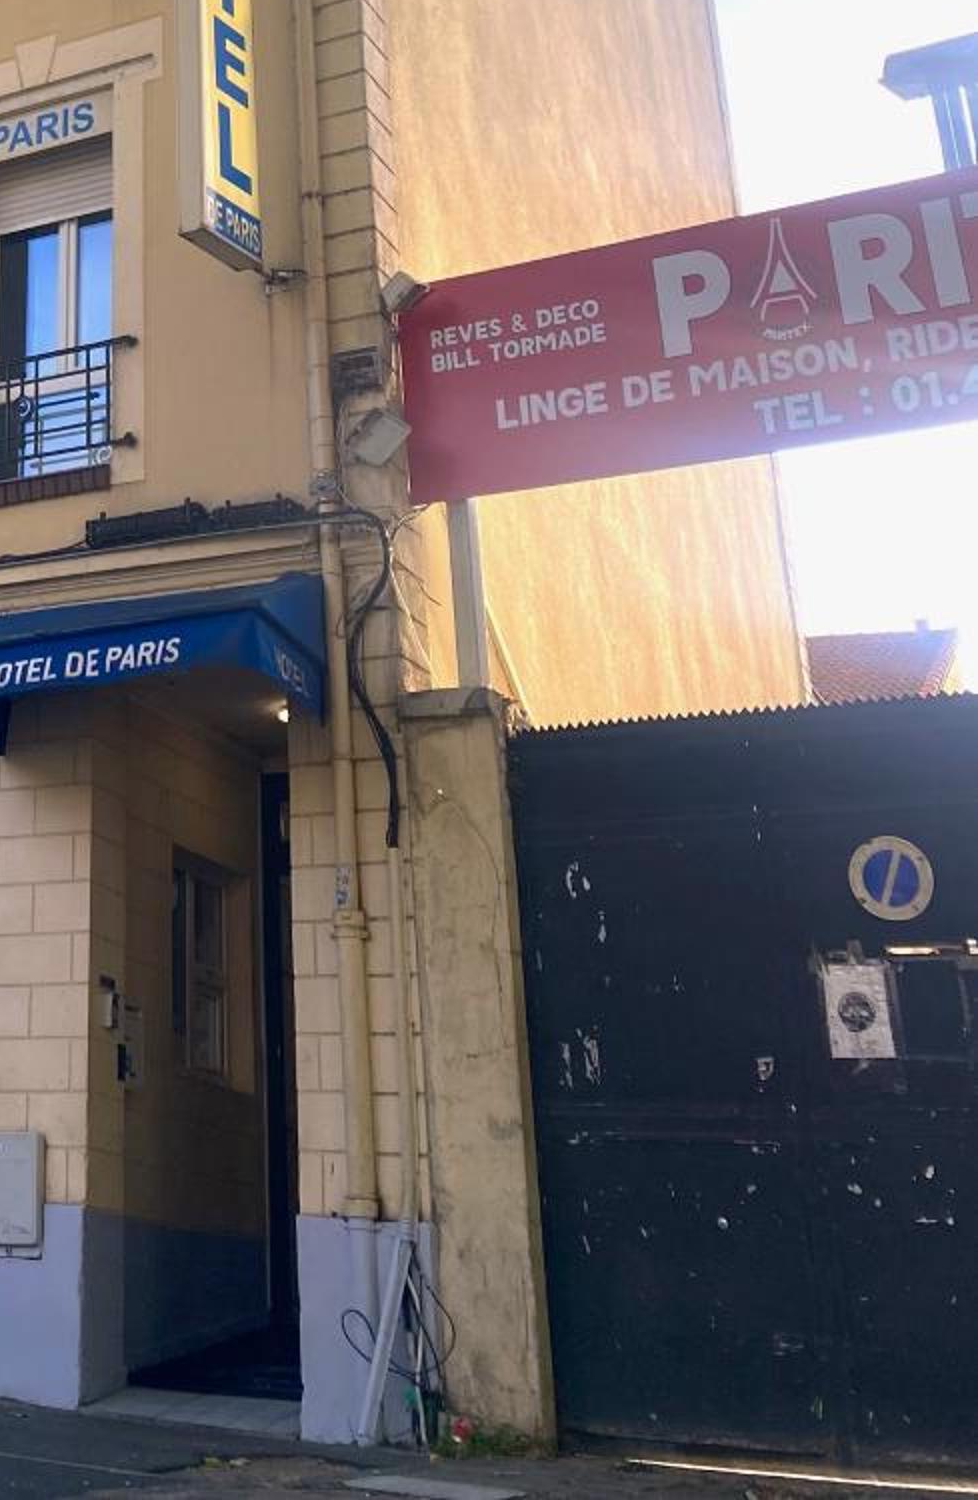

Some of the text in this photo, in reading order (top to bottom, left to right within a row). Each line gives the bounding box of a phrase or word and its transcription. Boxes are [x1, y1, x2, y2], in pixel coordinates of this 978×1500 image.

[225, 206, 261, 254] PARIS
[430, 300, 600, 349] REVES & DECO
[431, 323, 607, 373] BILL TORMADE
[496, 381, 609, 431] LINGE
[622, 370, 675, 409] DE
[689, 338, 873, 396] MAISON,
[754, 387, 844, 436] TEL
[65, 648, 99, 677] DE
[105, 636, 182, 671] PARIS
